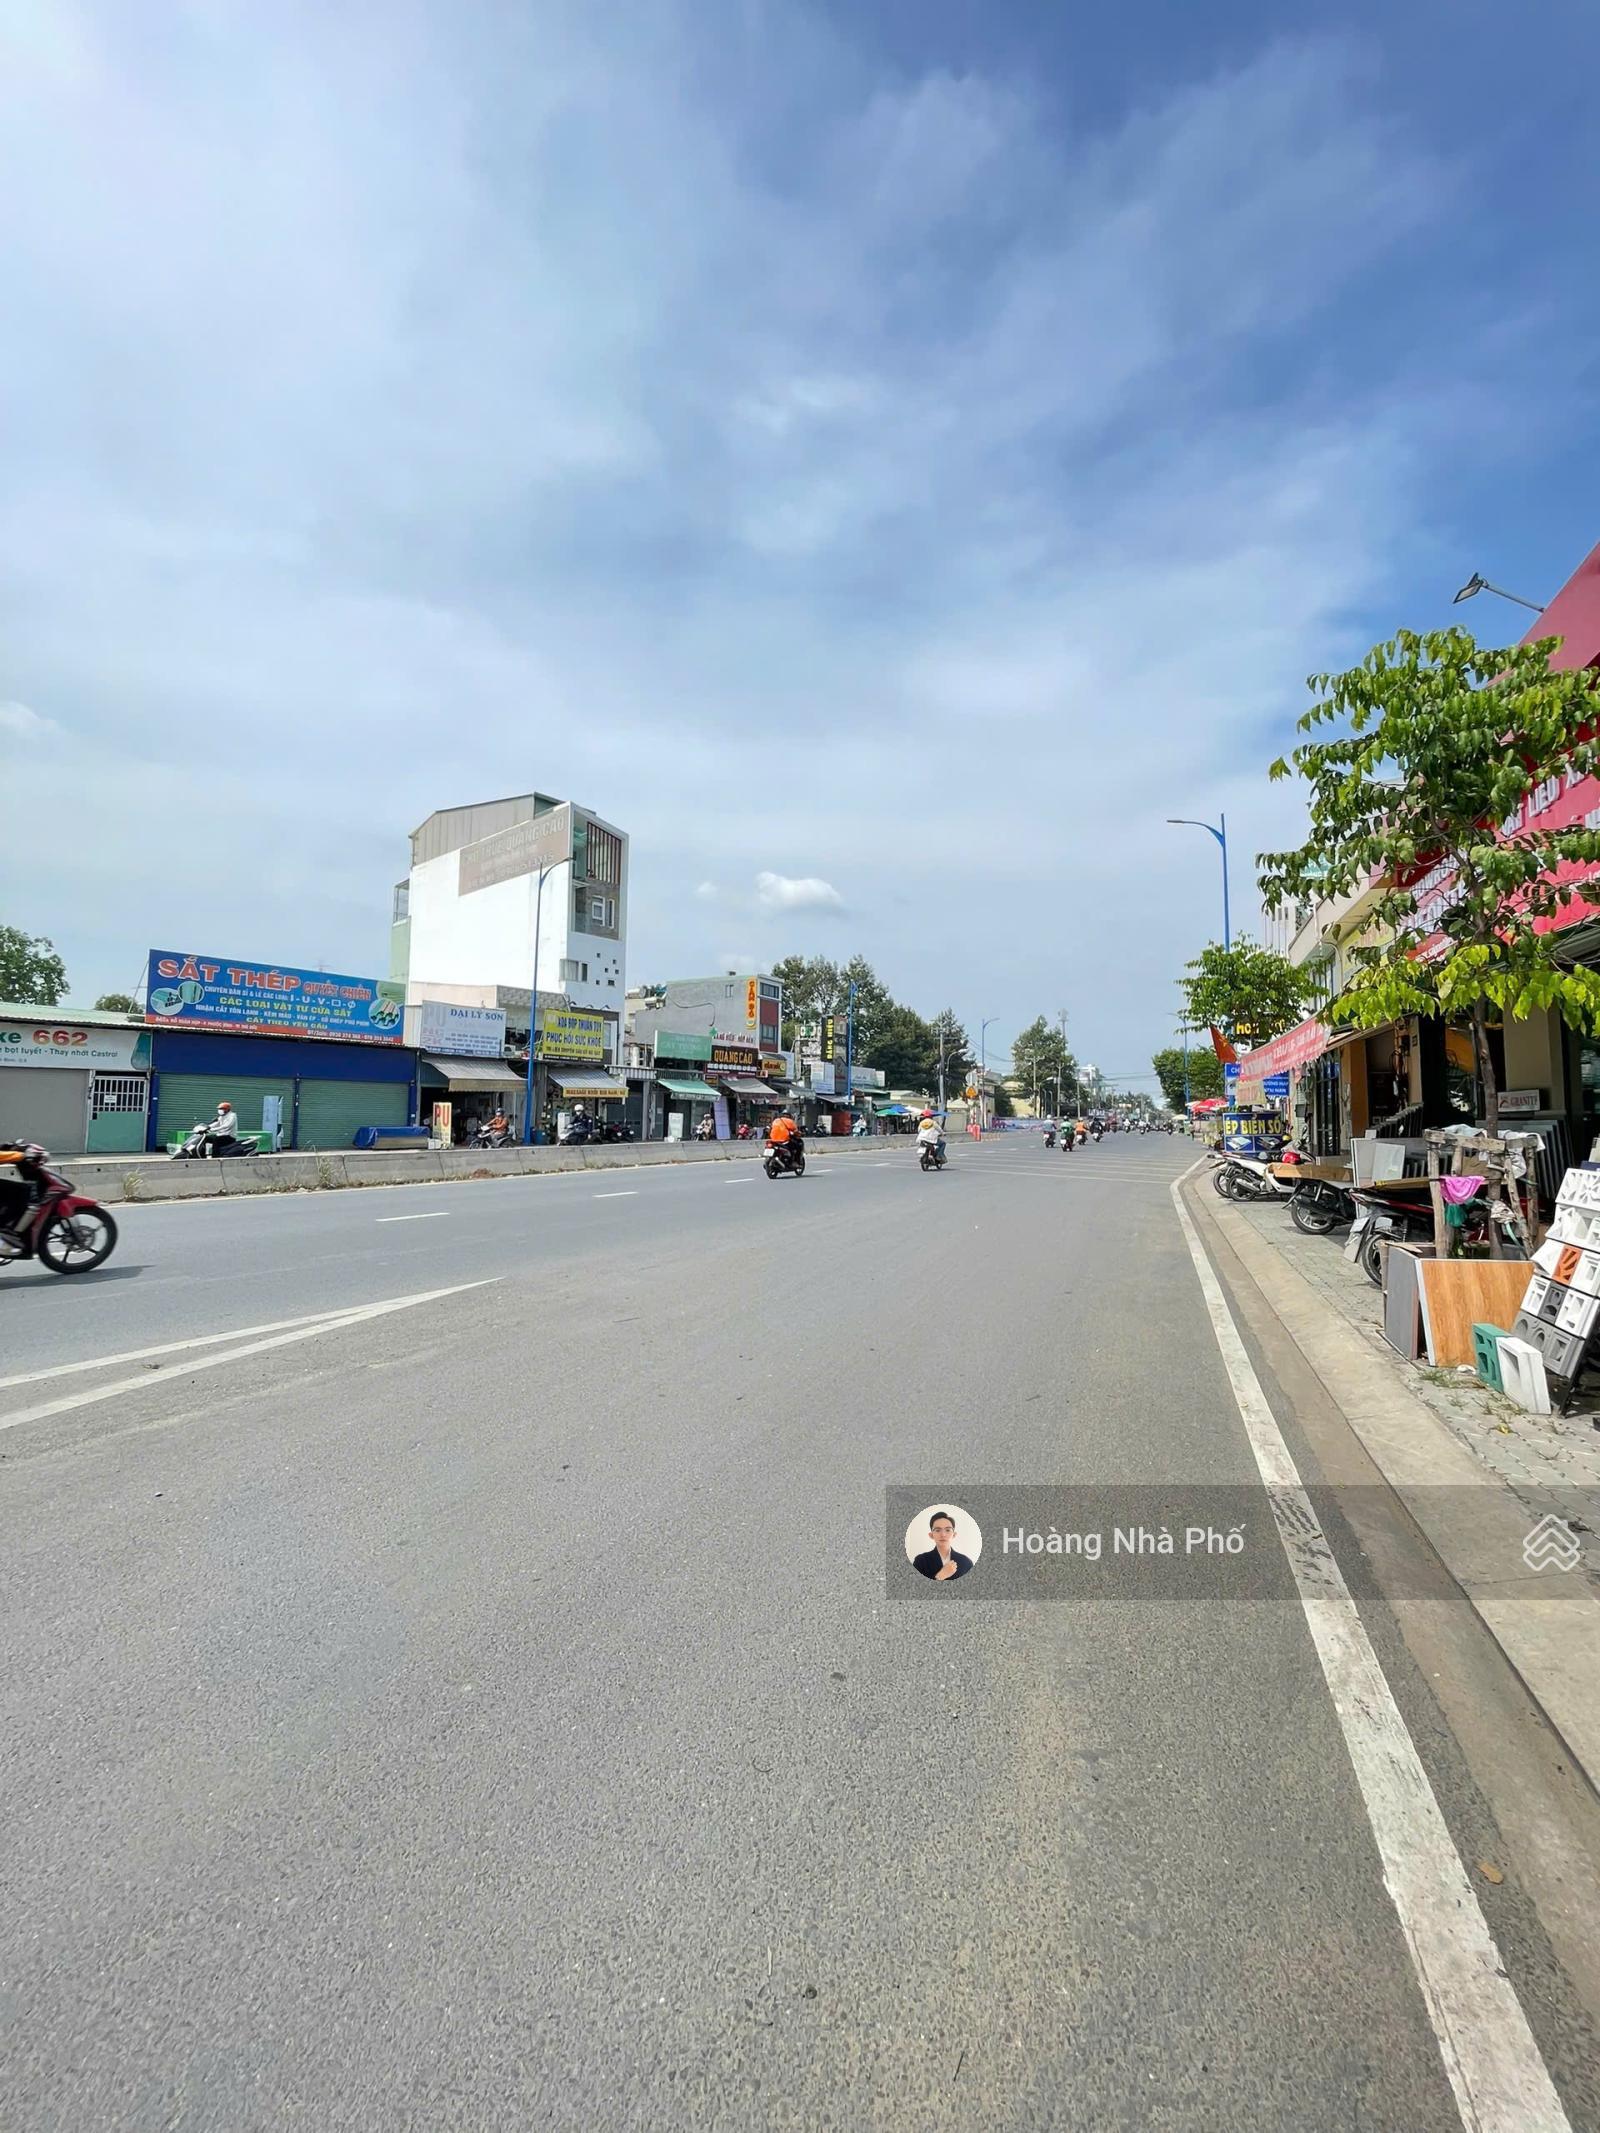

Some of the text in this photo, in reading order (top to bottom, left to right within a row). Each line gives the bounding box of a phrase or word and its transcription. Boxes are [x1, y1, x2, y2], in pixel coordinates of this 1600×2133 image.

[158, 955, 220, 982] SẮT
[227, 967, 301, 992] THÉP
[219, 995, 352, 1017] CÁC LOẠI VẬT TƯ CỬA SẮT
[246, 1016, 266, 1024] CẮT
[292, 1020, 308, 1028] YÊU
[32, 1029, 88, 1047] 662
[21, 1046, 42, 1055] tuyết
[50, 1048, 68, 1057] Thay
[91, 1050, 118, 1058] Castrol
[714, 1047, 753, 1064] QUẢNG CÁO
[434, 1104, 449, 1127] PU
[1225, 1114, 1281, 1134] ÉP BIỂN SỐ
